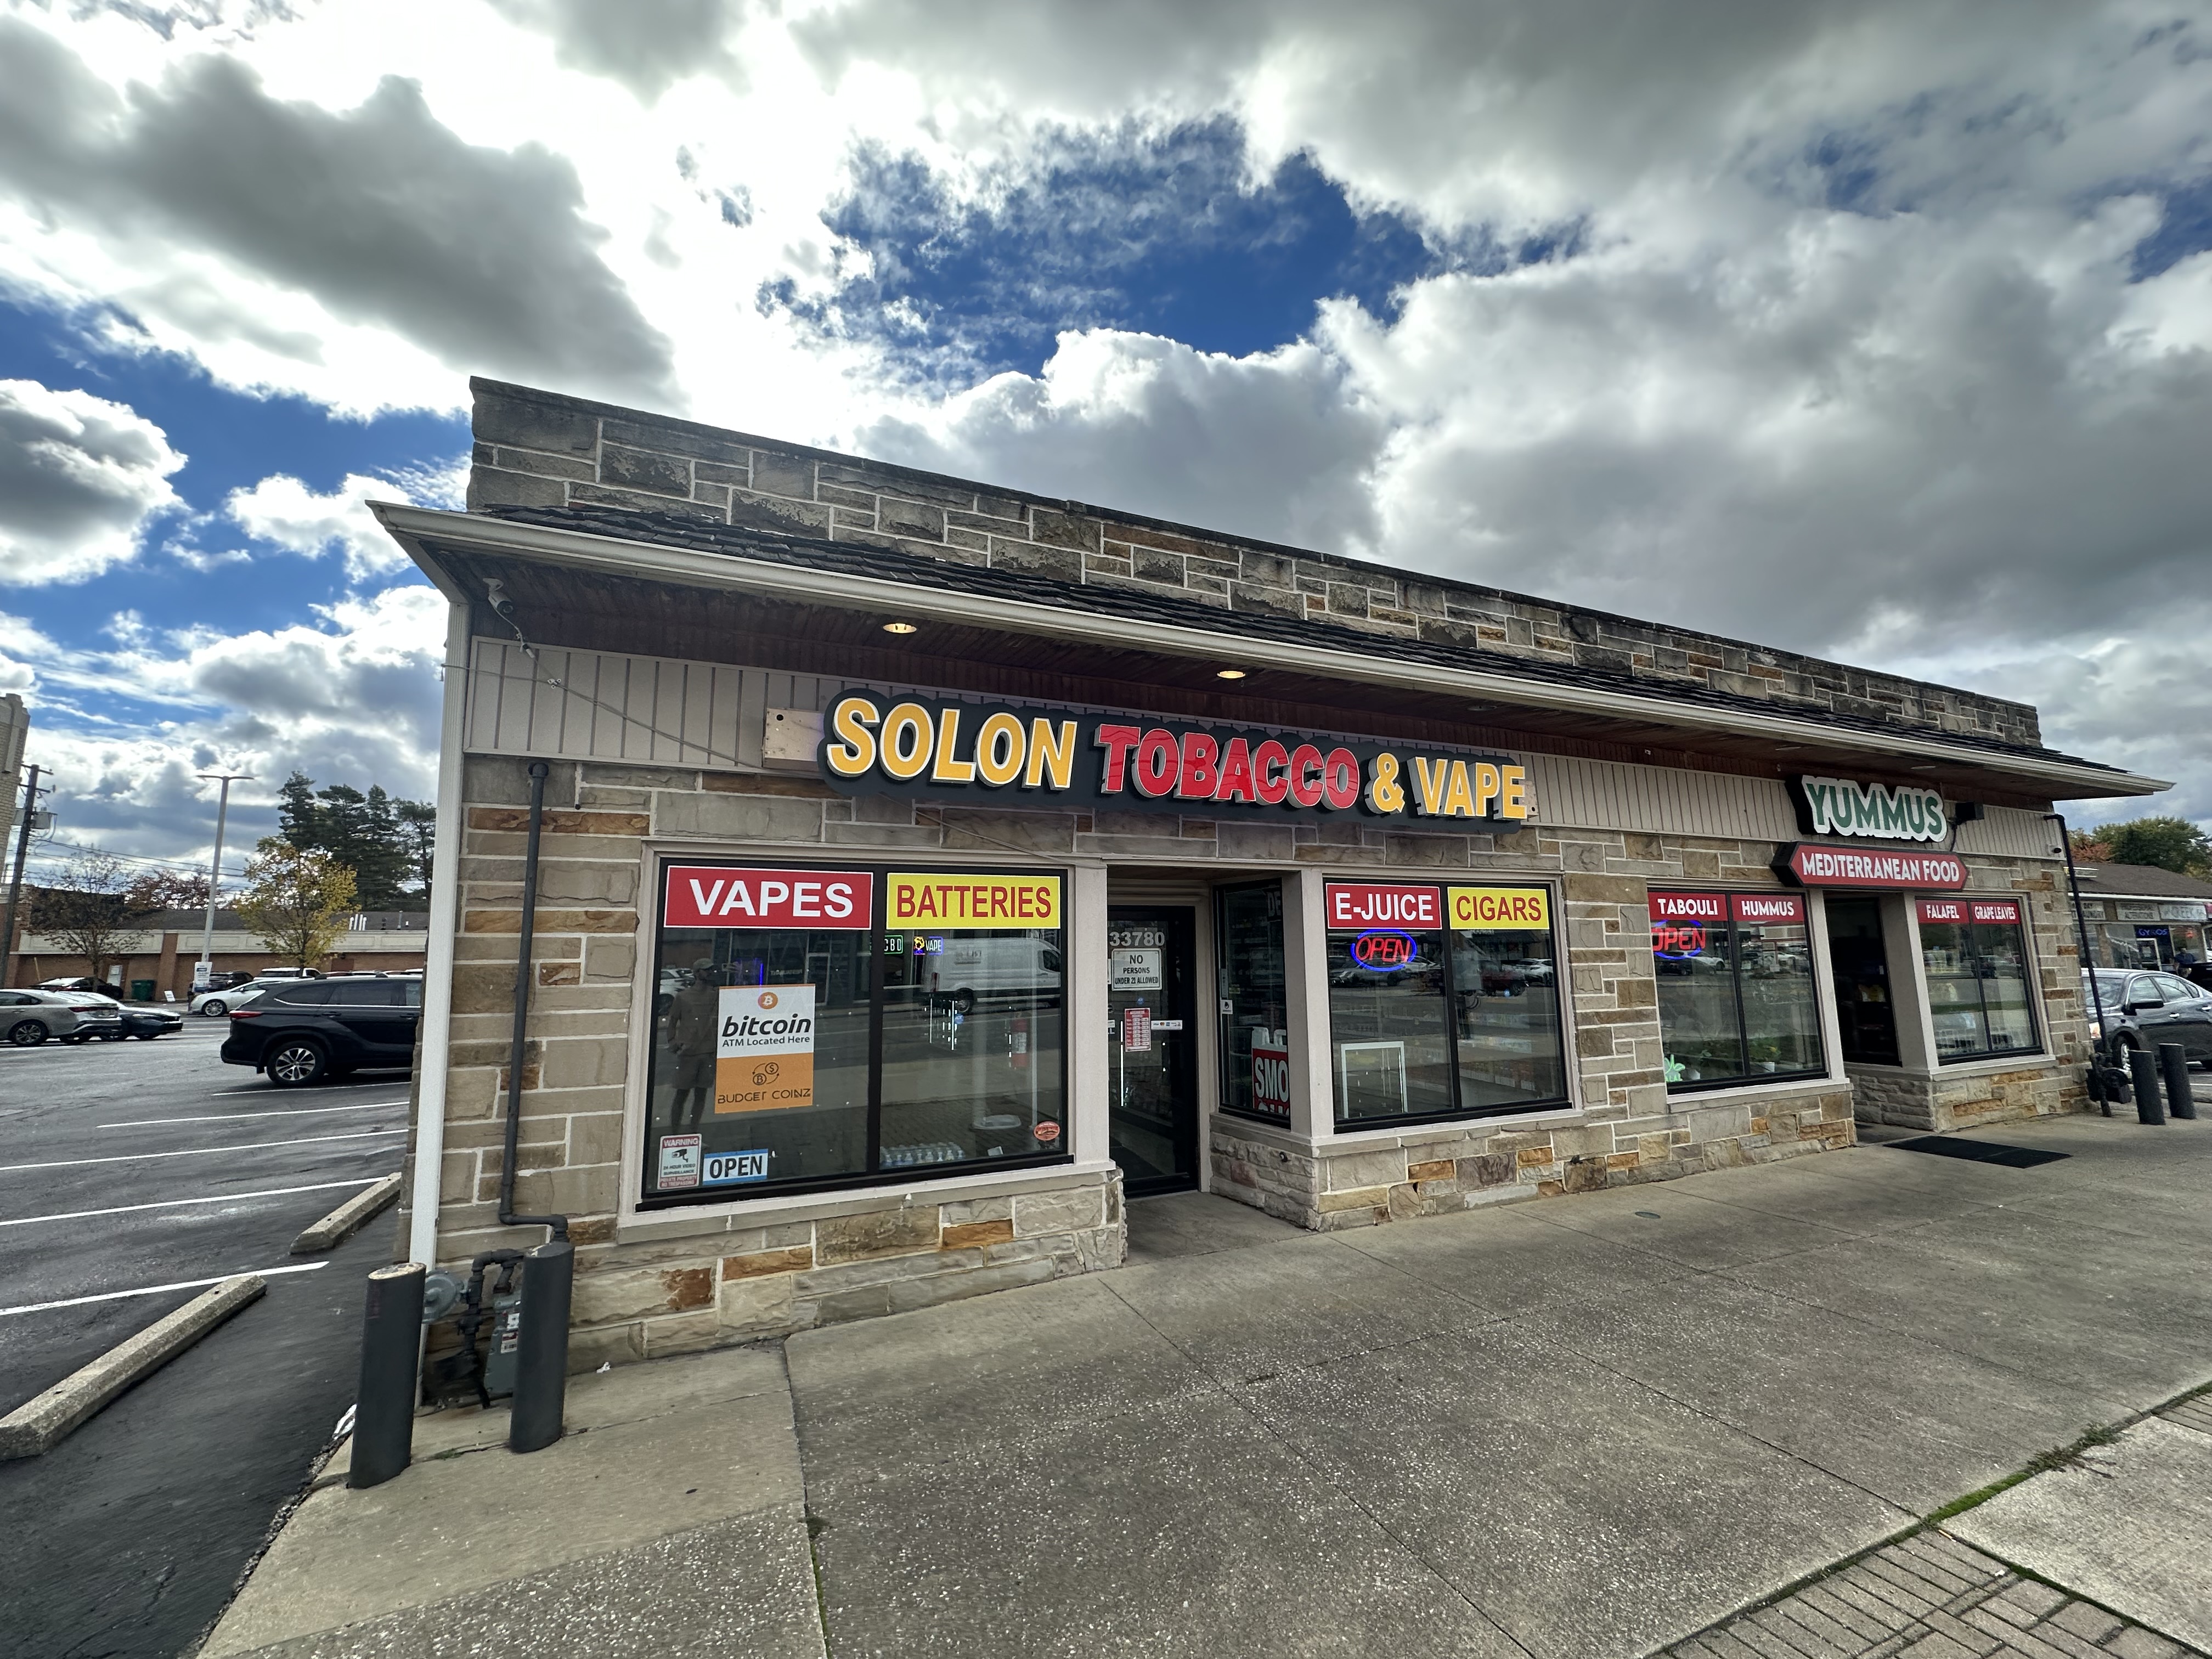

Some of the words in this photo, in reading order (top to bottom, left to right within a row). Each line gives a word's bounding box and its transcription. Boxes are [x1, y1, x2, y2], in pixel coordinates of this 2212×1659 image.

[826, 697, 1077, 791] SOLON
[1094, 723, 1360, 810] TOBACCO
[1364, 752, 1405, 814] &
[1407, 756, 1527, 820] VAPE
[1805, 783, 1942, 835] YUMMUS
[1802, 852, 1920, 881] MEDITERRANEAN
[1922, 859, 1960, 882] FOOD
[690, 878, 853, 918] VAPES
[896, 885, 1052, 918] BATTERIES
[1335, 893, 1434, 921] E-JUICE
[1456, 895, 1542, 922] CIGARS
[1657, 898, 1718, 915] TABOULI
[1741, 900, 1795, 916] HUMMUS
[1926, 905, 1960, 919] FALAFEL
[1974, 906, 1994, 919] GRAPE
[1995, 906, 2016, 919] LEAVES
[925, 939, 942, 951] VAPE
[1109, 931, 1165, 946] 33780
[1355, 936, 1411, 962] OPEN
[1651, 927, 1706, 951] OPEN
[1130, 955, 1143, 964] NO
[722, 1013, 811, 1037] bitcoin
[722, 1039, 744, 1047] ATM
[747, 1036, 785, 1046] Located
[718, 1091, 767, 1104] BUDGET
[772, 1088, 811, 1099] COINZ
[664, 1138, 698, 1147] WARNING
[709, 1155, 763, 1179] OPEN
